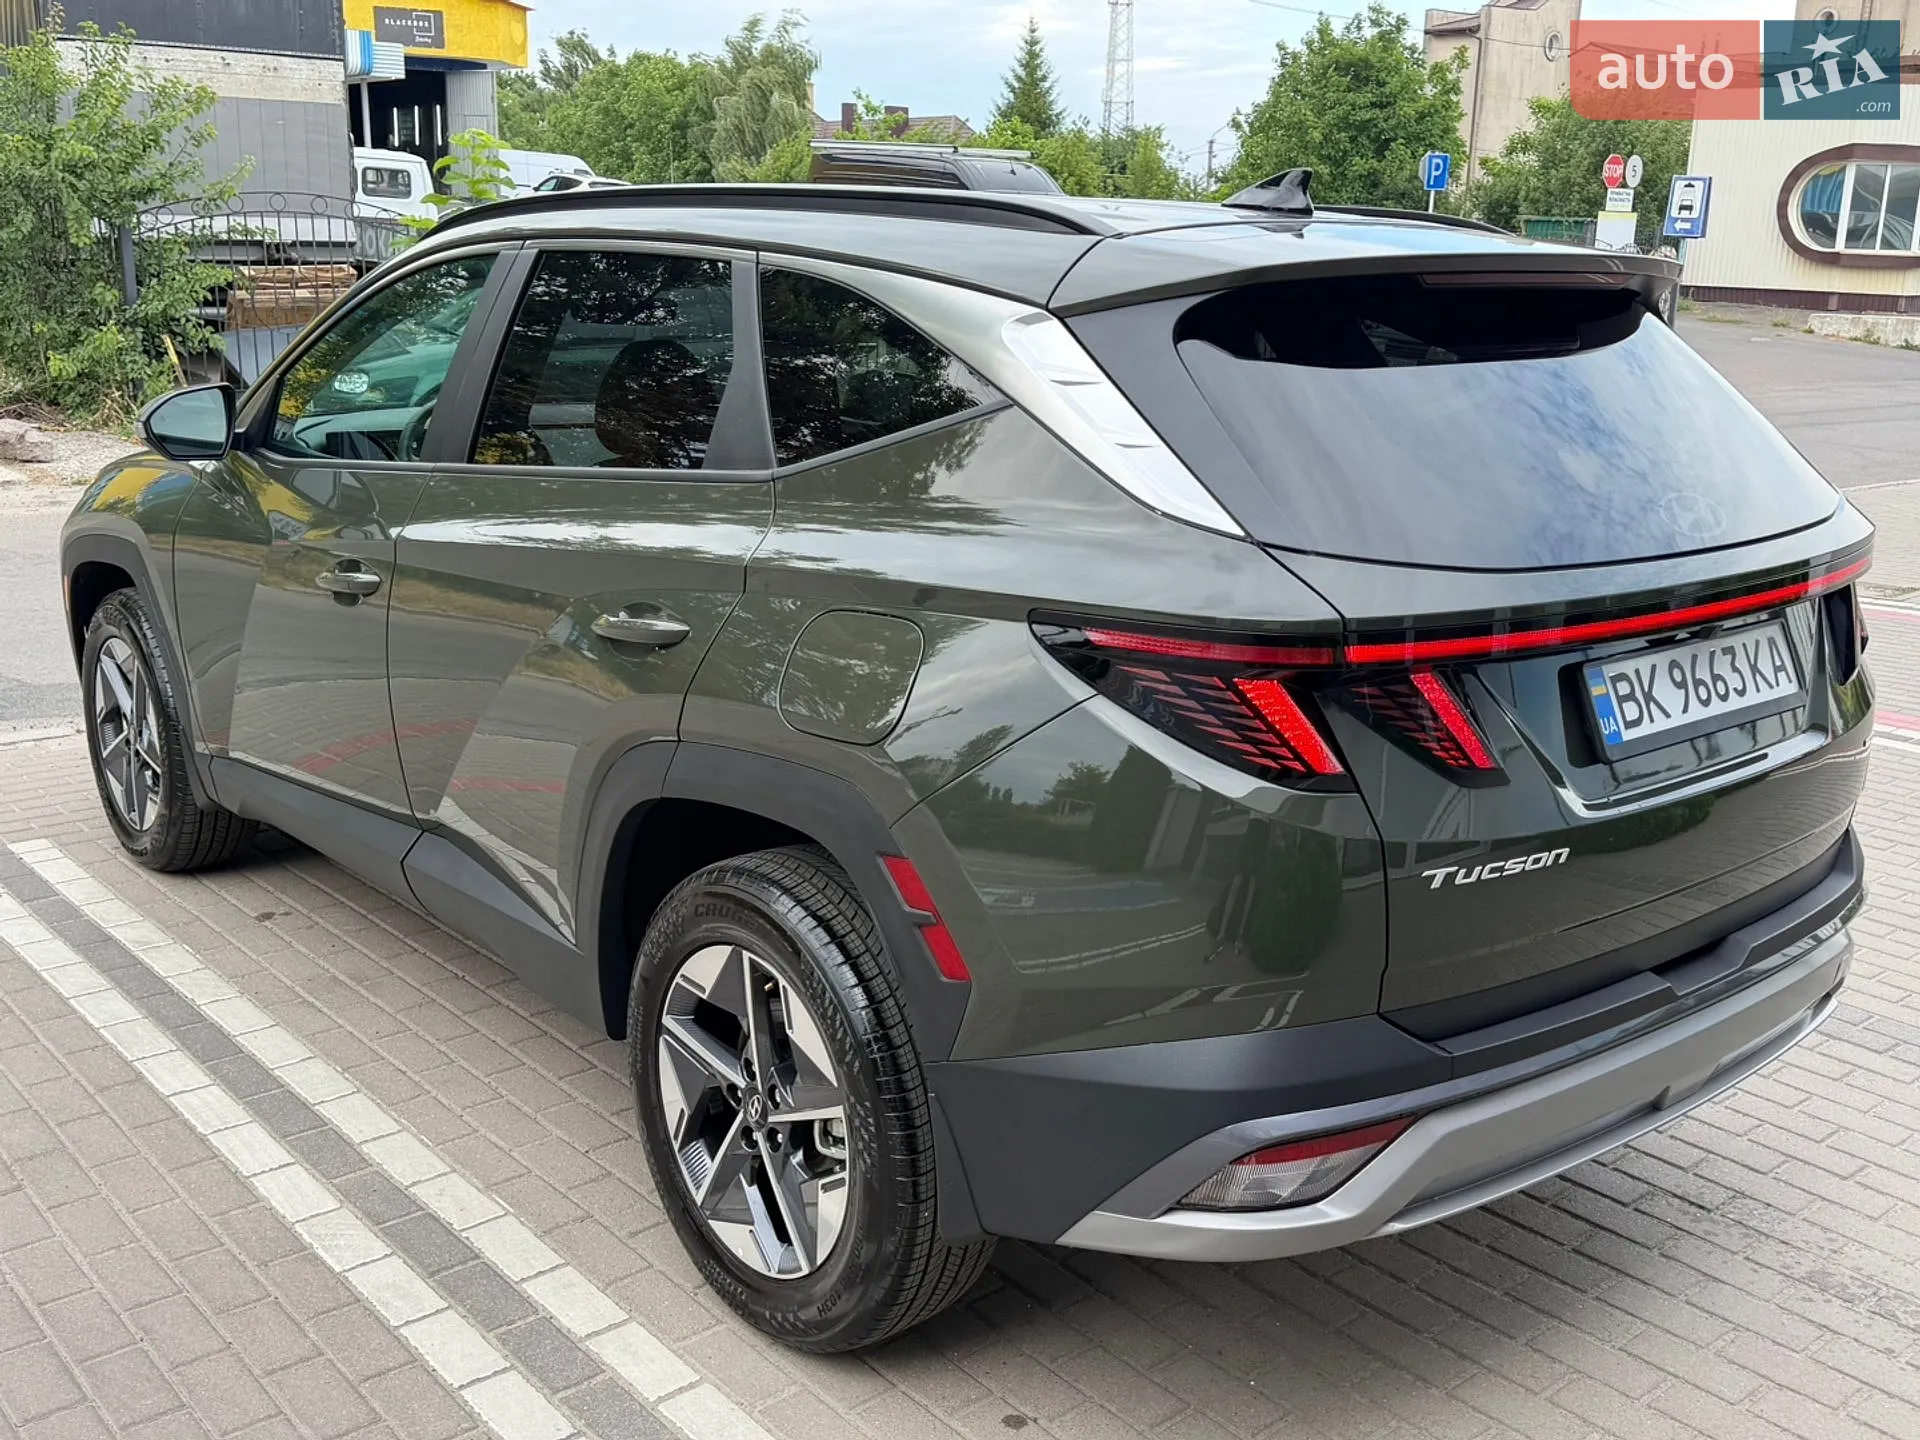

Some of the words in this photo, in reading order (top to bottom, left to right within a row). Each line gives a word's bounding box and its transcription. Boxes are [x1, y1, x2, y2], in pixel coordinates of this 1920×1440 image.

[1429, 158, 1444, 186] P
[1604, 163, 1623, 178] STOP
[1631, 164, 1637, 178] 5
[1608, 662, 1672, 731] BK
[1668, 645, 1748, 715] 9663
[1742, 635, 1794, 694] KA
[1601, 716, 1619, 735] UA
